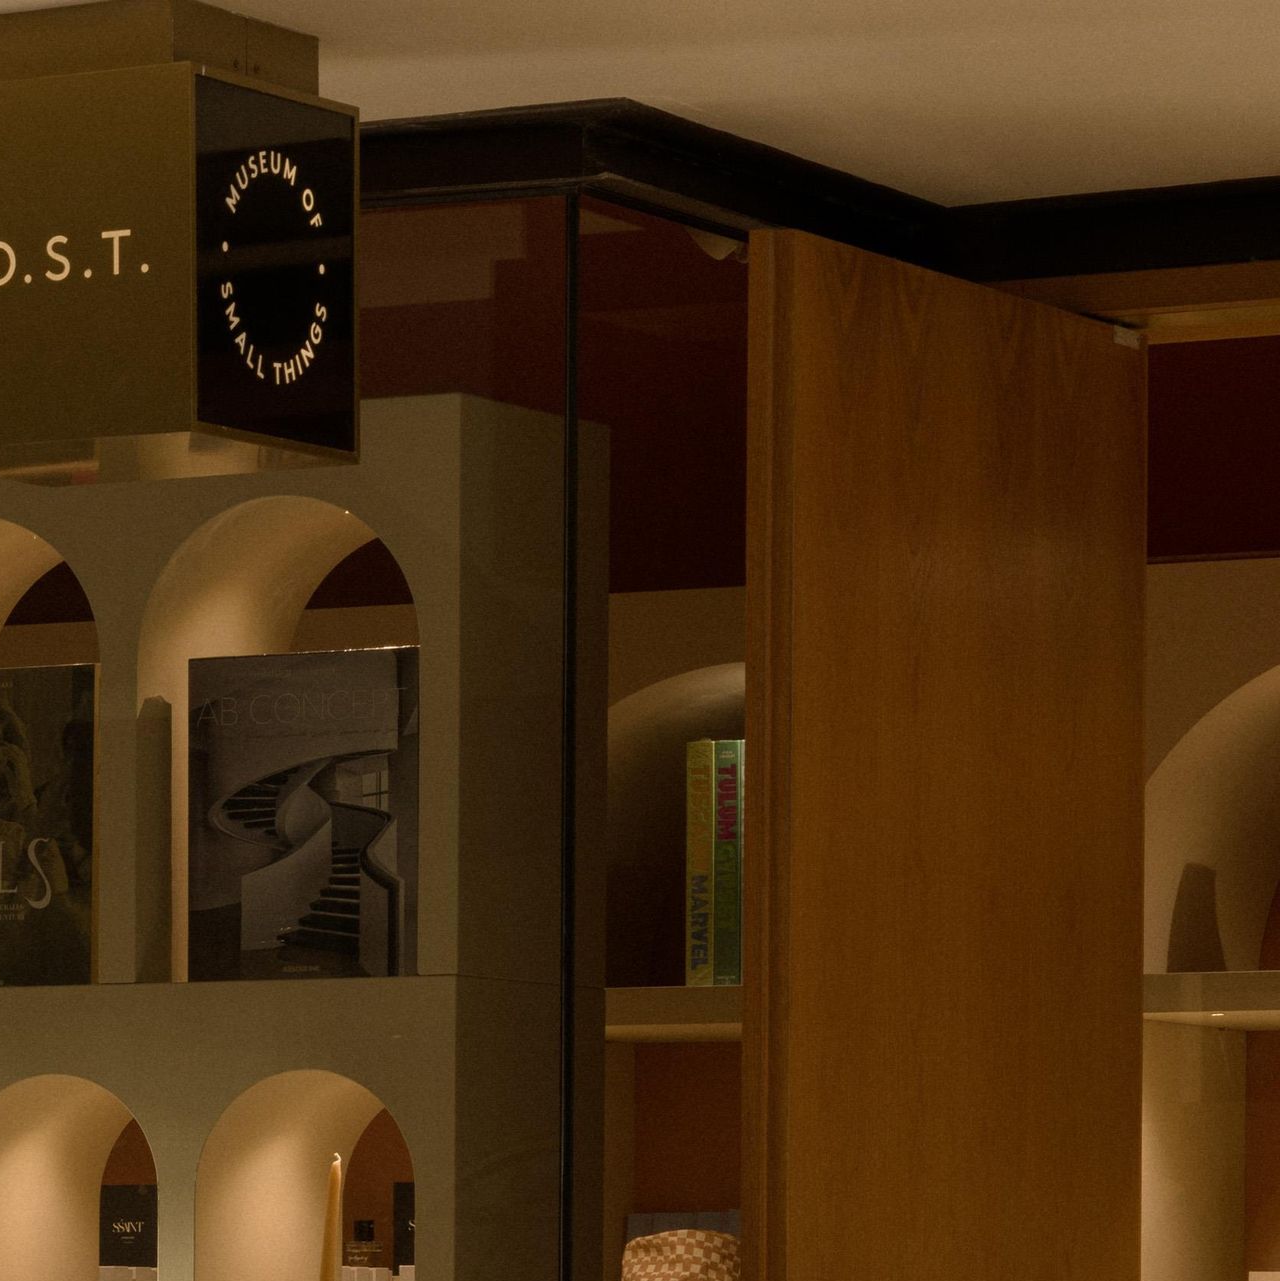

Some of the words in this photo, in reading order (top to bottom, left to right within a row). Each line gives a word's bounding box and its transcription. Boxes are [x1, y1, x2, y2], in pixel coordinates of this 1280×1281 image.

[224, 150, 297, 214] MUSEUM
[302, 188, 322, 229] OF
[221, 281, 265, 379] SMALL
[272, 303, 327, 386] THINGS
[718, 763, 736, 840] TULUM
[692, 874, 709, 970] MARVEL
